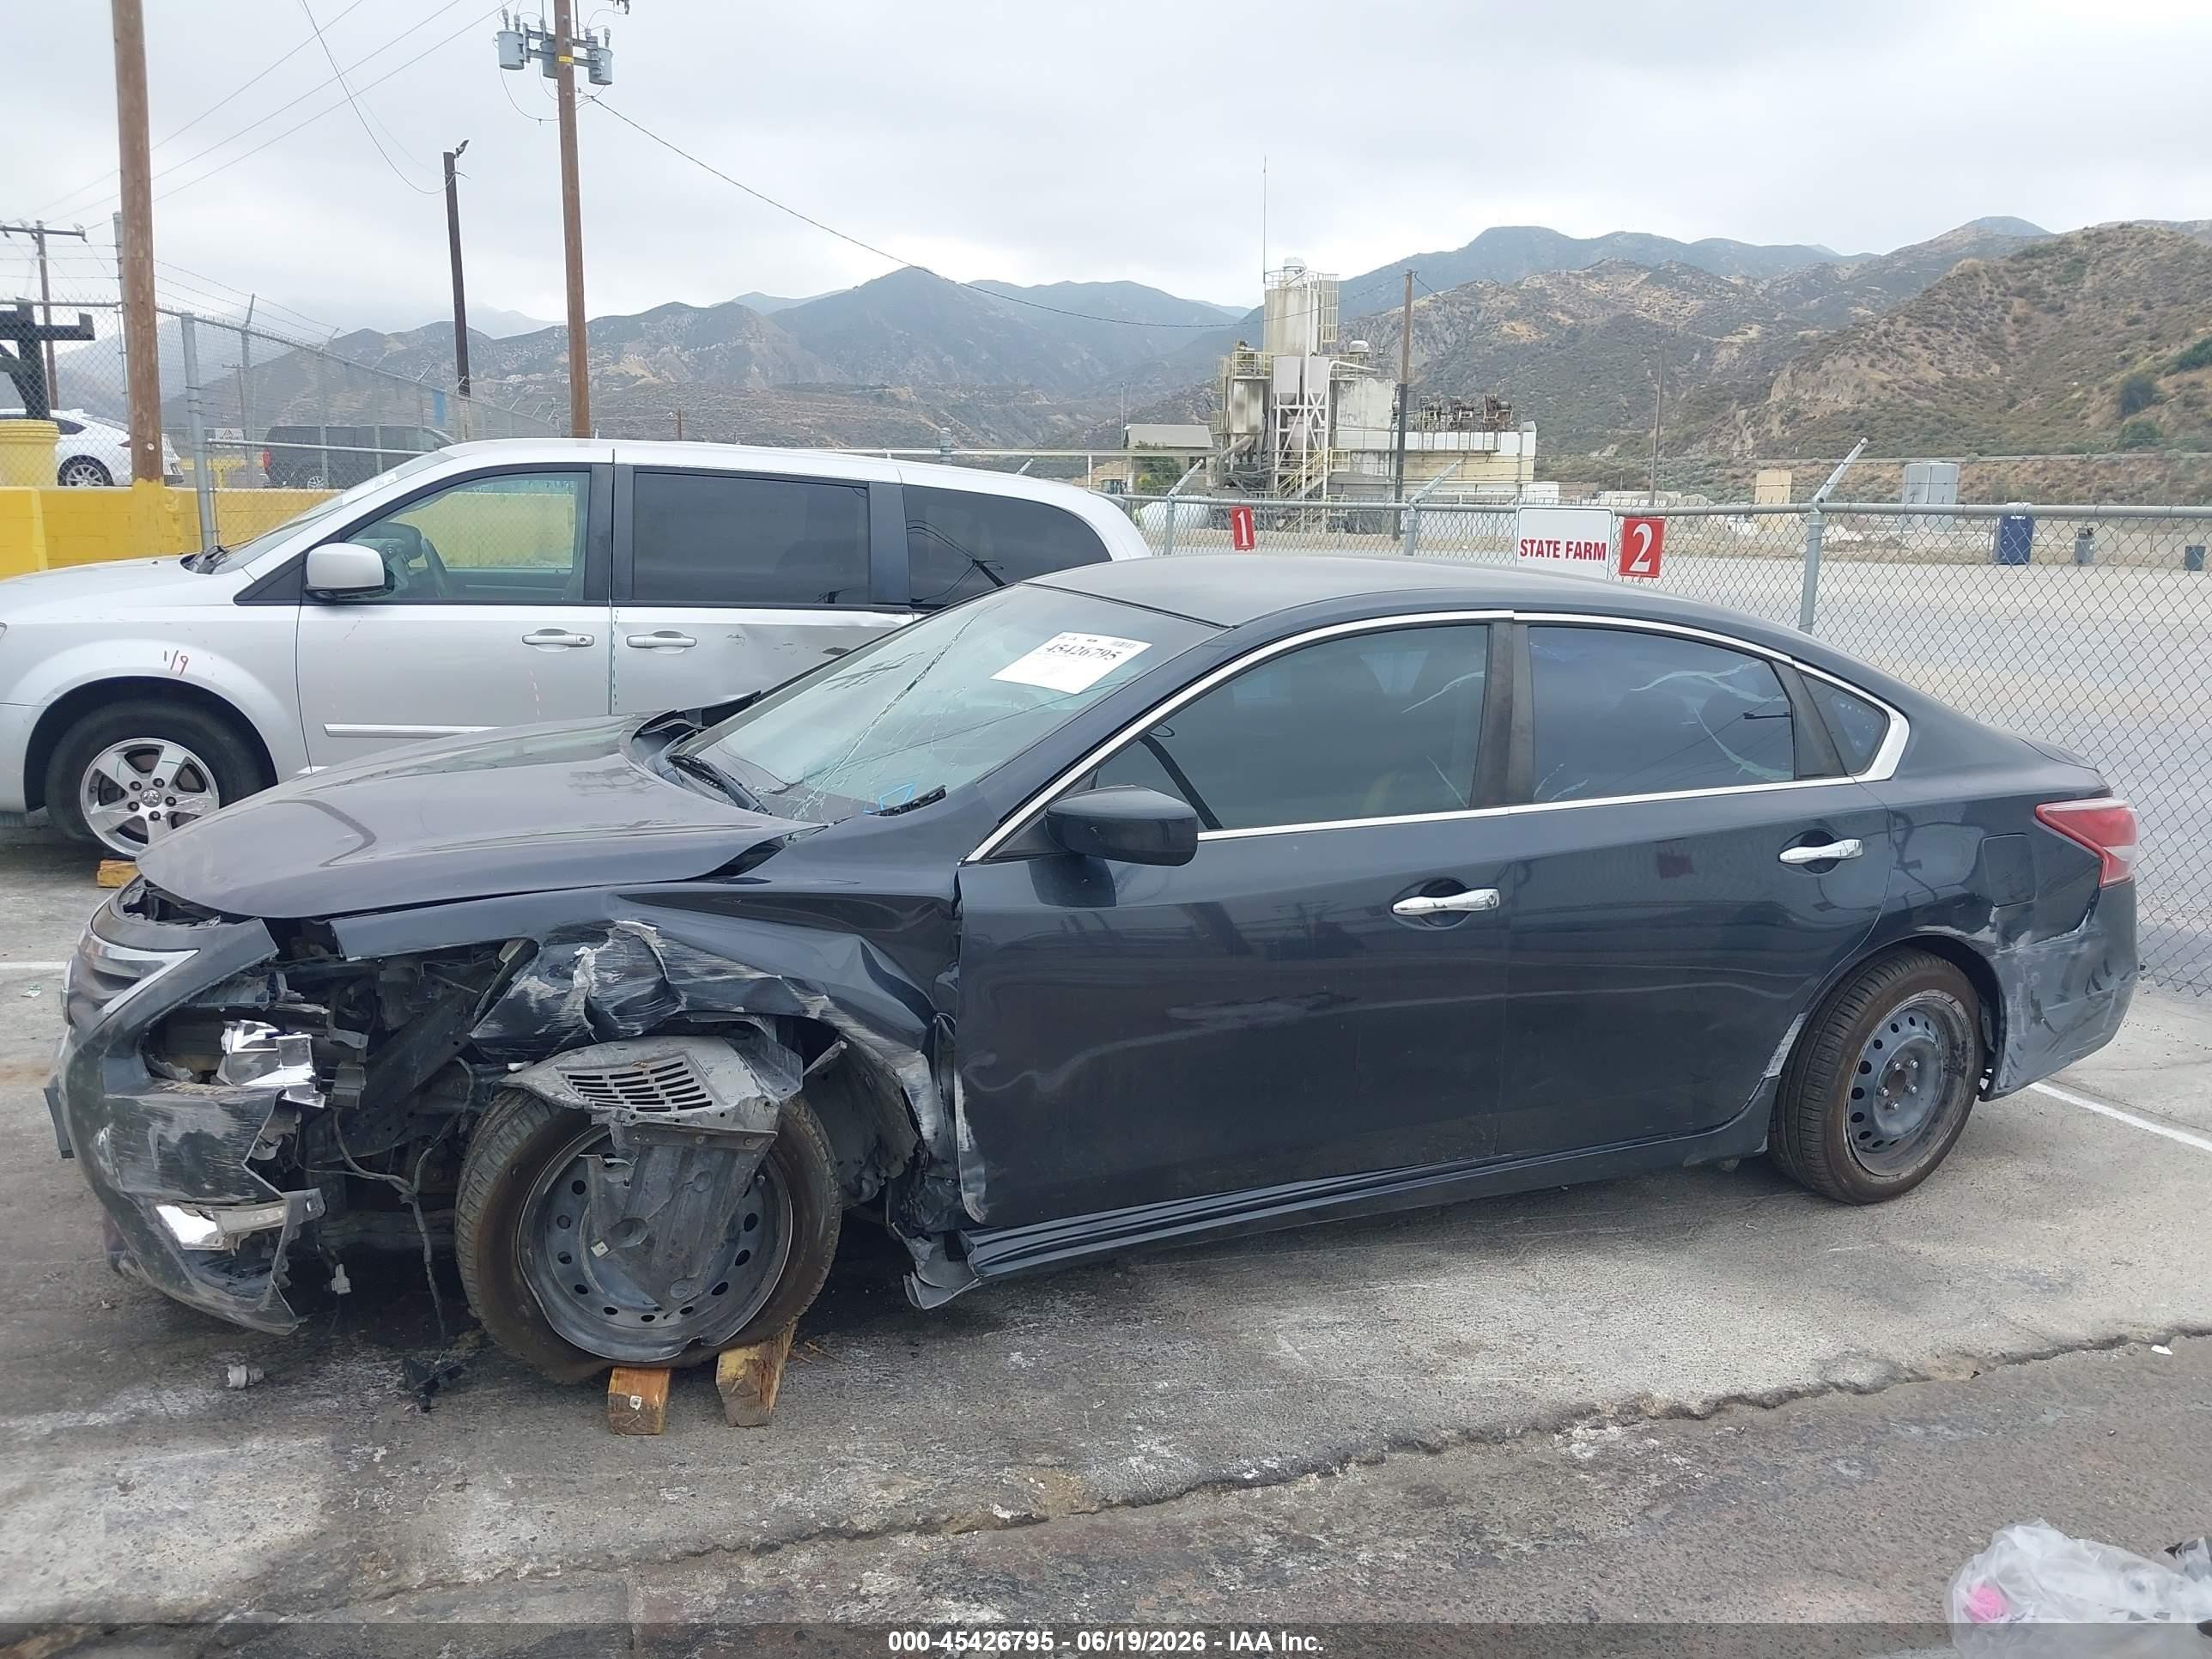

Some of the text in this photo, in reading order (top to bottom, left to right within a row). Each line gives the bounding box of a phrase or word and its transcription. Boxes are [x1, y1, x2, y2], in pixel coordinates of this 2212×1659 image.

[1237, 510, 1250, 546] 1
[1520, 538, 1607, 561] STATE FARM
[1629, 524, 1653, 573] 2
[1046, 643, 1122, 660] 45426795
